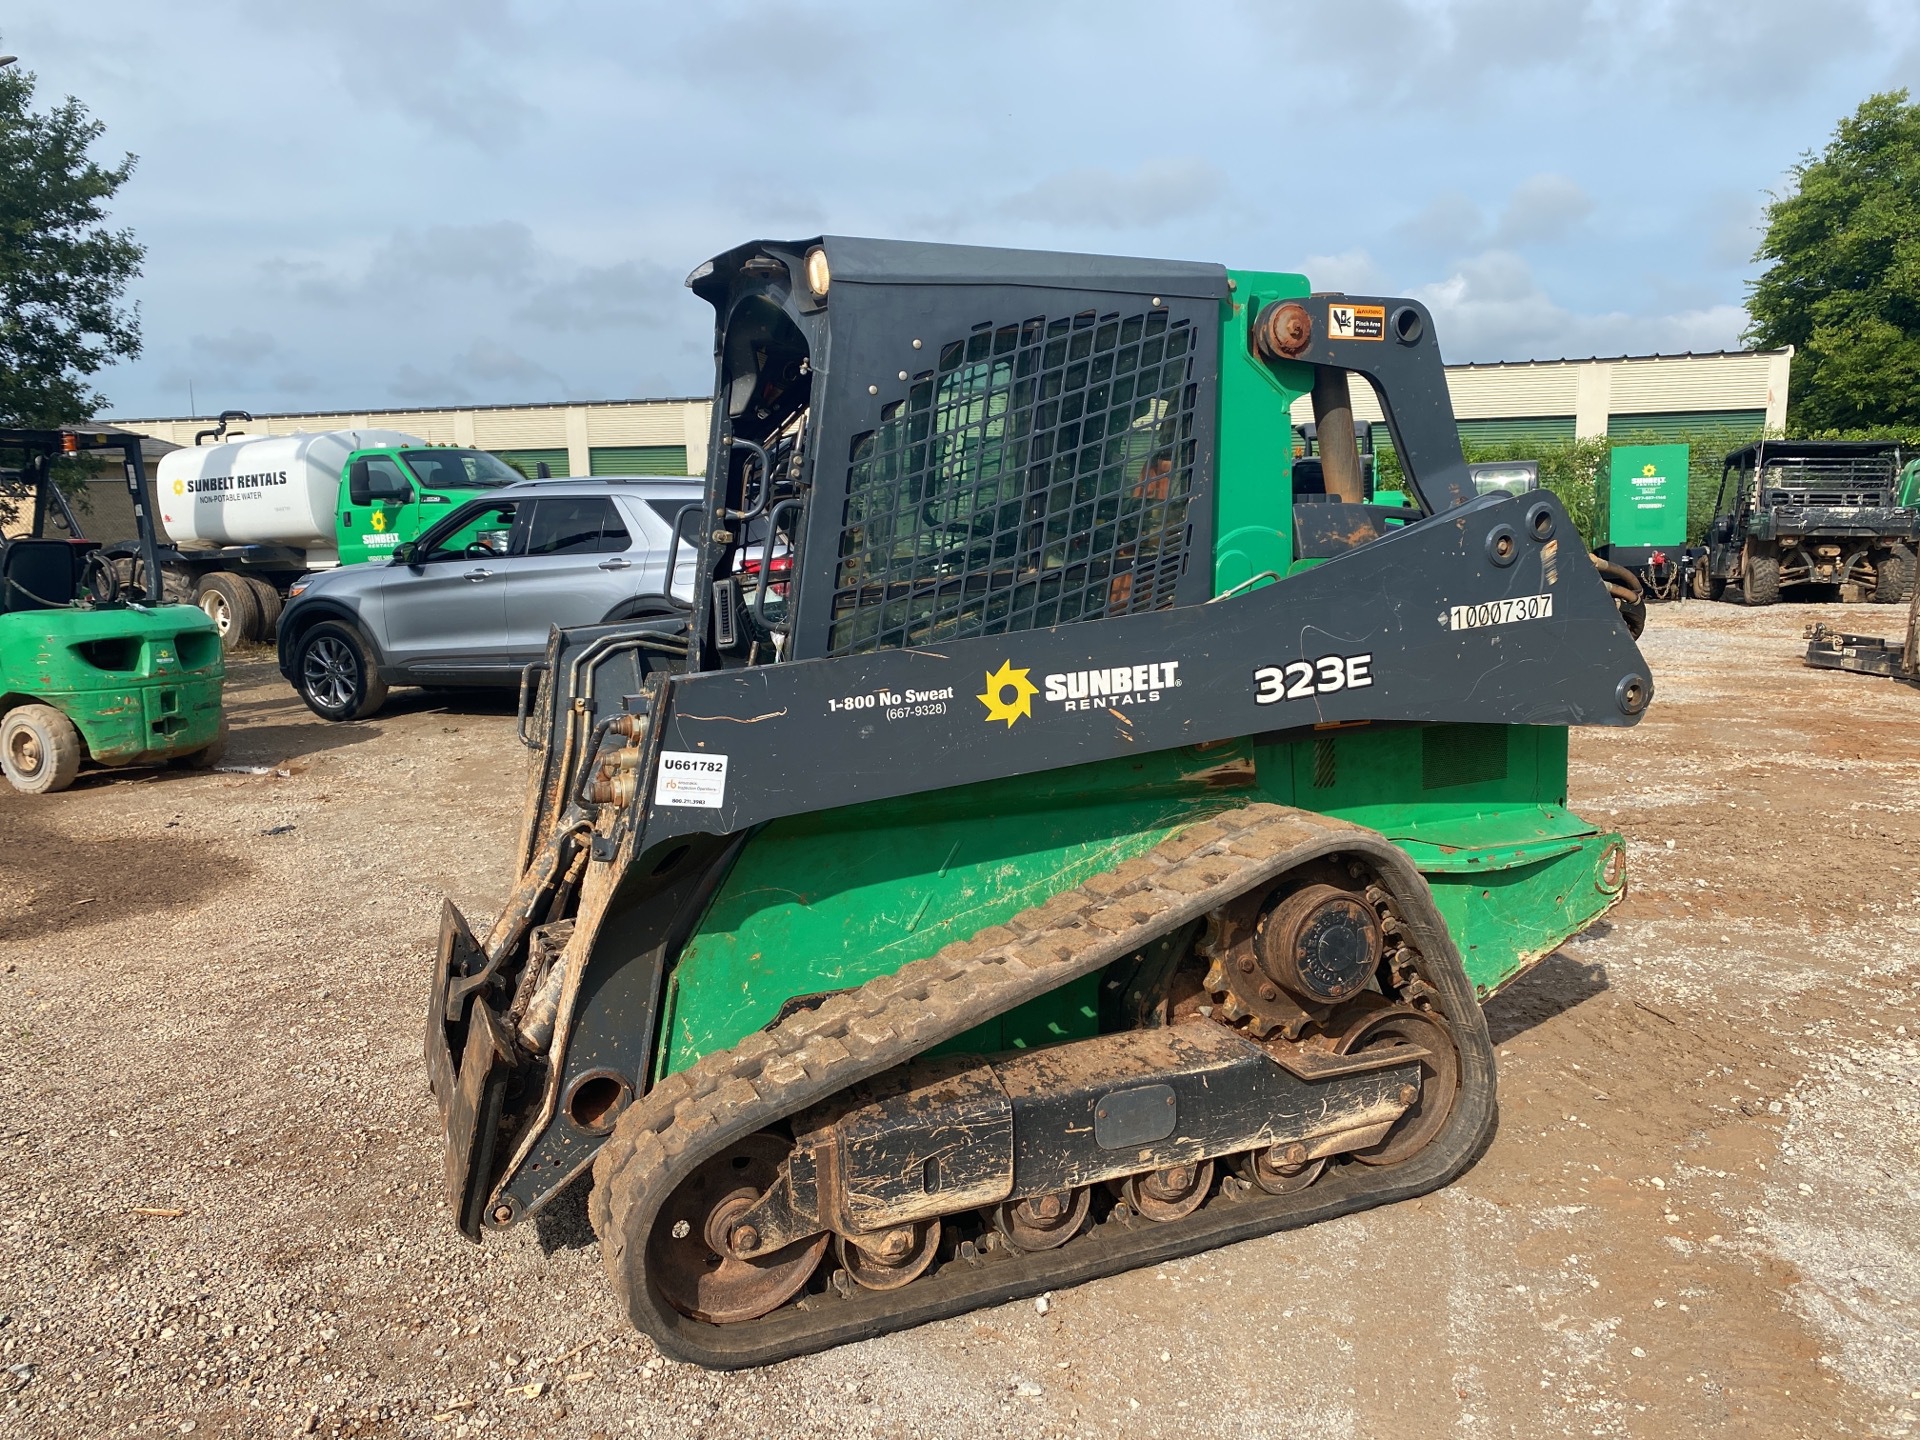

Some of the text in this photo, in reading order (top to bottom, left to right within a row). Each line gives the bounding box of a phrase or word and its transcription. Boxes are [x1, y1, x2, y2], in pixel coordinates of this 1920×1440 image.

[187, 471, 287, 493] SUNBELT RENTALS
[199, 491, 262, 504] NON-POTABLE WATER
[362, 533, 400, 545] SUNBELT
[1452, 596, 1552, 630] 10007307
[1253, 653, 1373, 706] 323E
[827, 685, 954, 713] 1-800 No Sweat
[1064, 690, 1161, 712] RENTALS
[885, 701, 947, 723] (667-9328)
[664, 759, 723, 772] U661782
